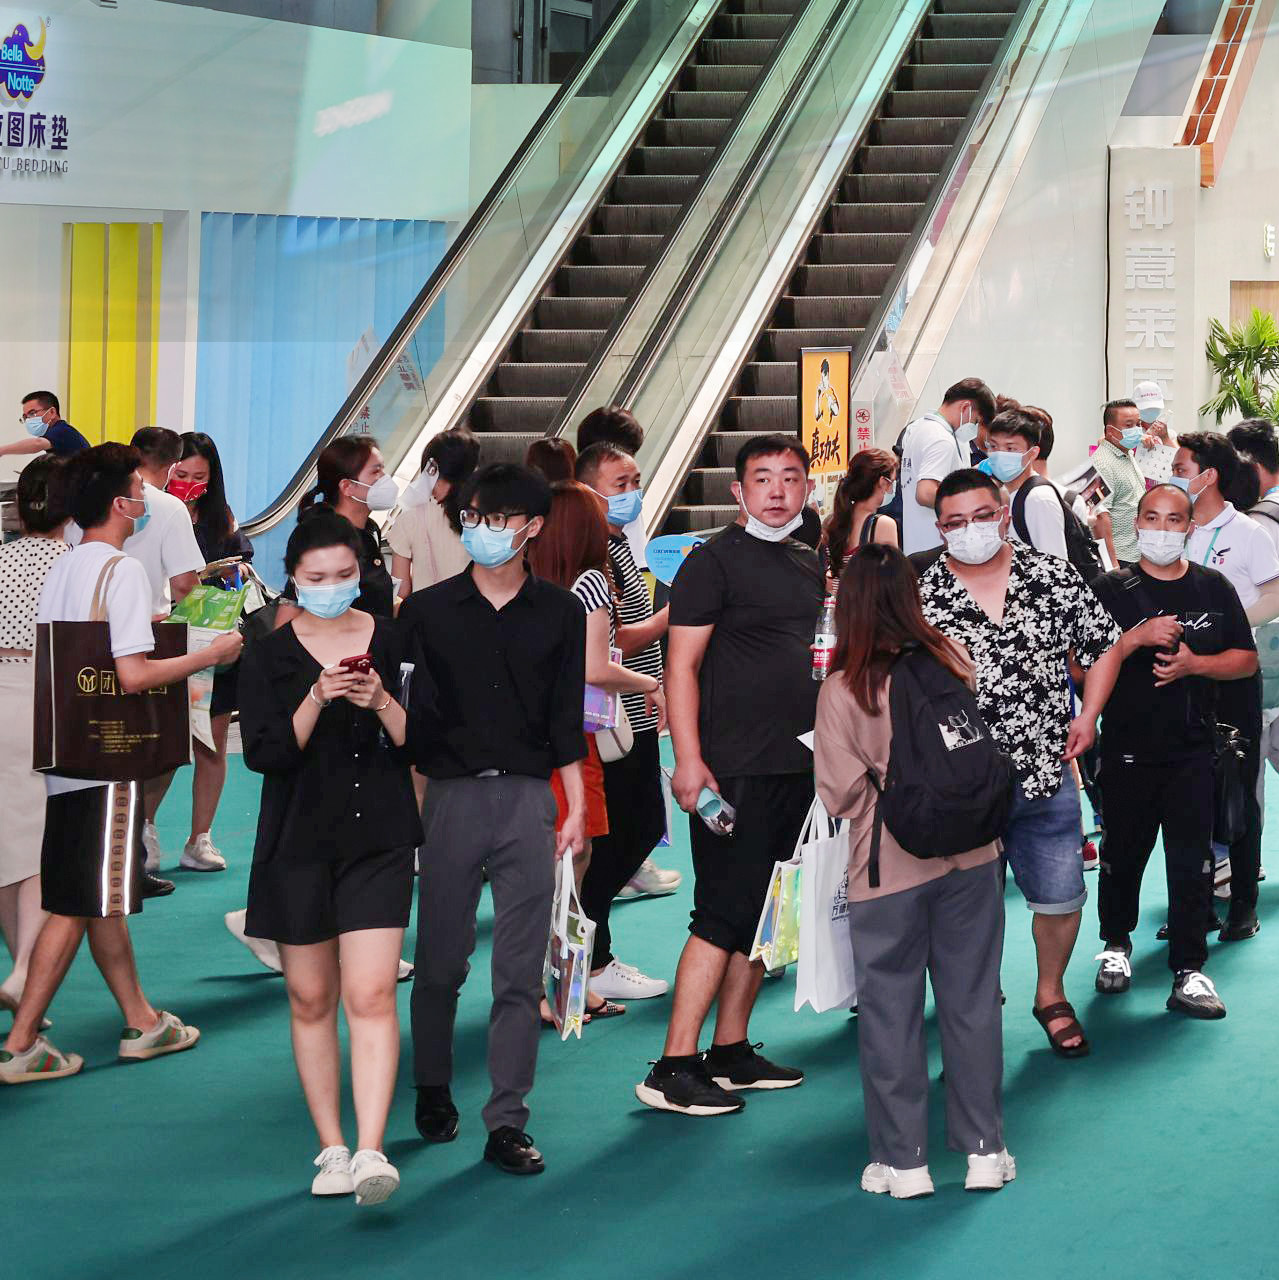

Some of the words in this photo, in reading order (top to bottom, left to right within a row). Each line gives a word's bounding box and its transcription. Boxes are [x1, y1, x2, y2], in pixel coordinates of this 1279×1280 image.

[1, 43, 23, 62] Bella
[8, 72, 35, 92] Notte
[0, 111, 69, 150] 图床垫
[17, 158, 69, 173] BEDDING
[810, 426, 841, 470] 真功夫
